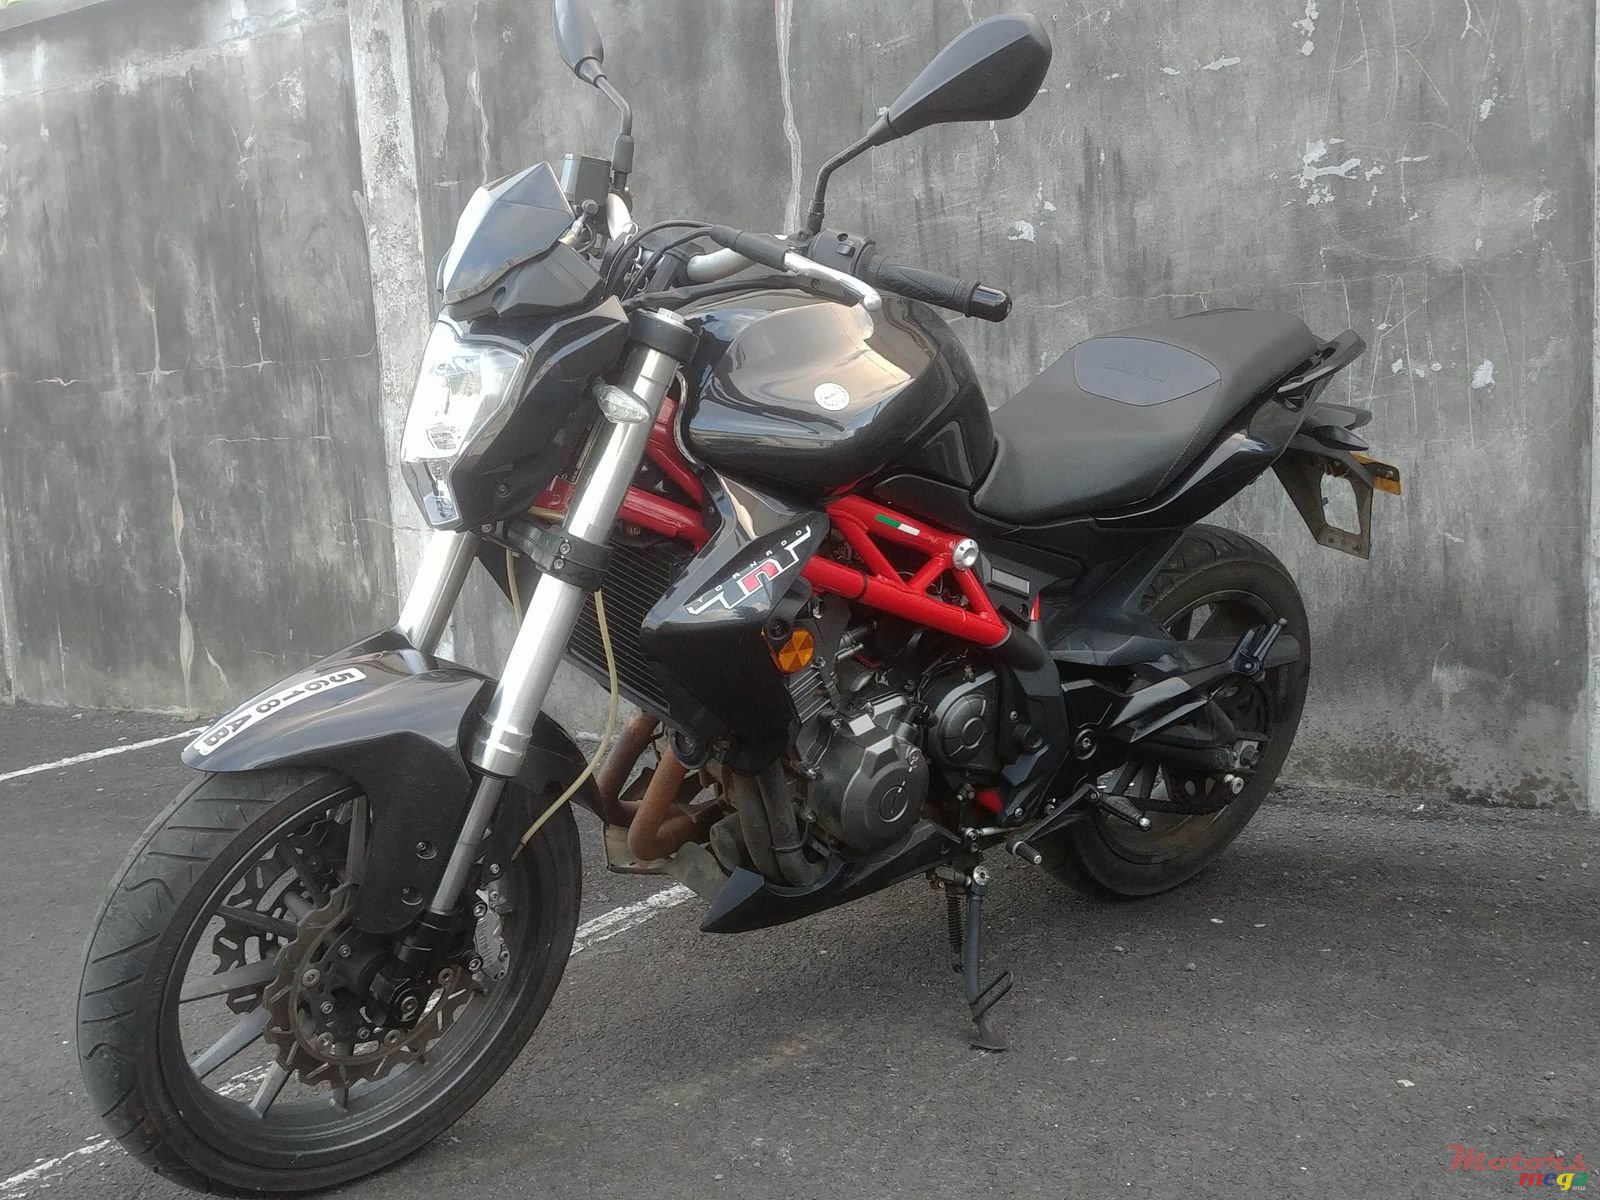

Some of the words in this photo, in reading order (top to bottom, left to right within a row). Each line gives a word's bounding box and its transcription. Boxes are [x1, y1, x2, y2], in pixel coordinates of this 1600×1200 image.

[696, 530, 803, 604] TORNADO
[255, 671, 355, 714] 5618
[203, 714, 253, 747] AB
